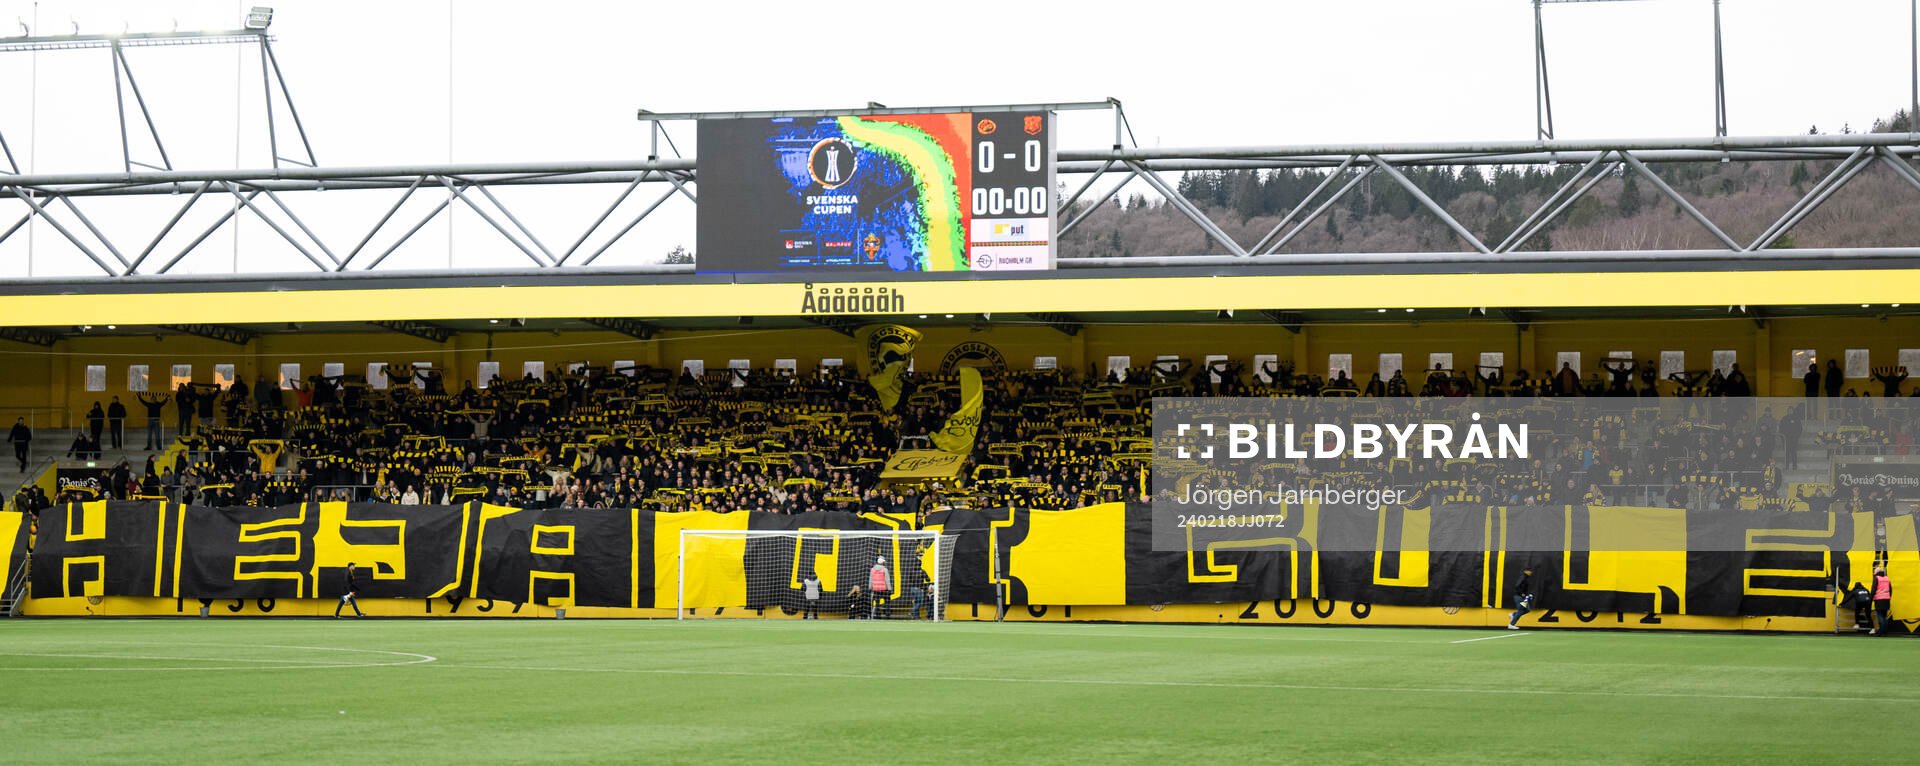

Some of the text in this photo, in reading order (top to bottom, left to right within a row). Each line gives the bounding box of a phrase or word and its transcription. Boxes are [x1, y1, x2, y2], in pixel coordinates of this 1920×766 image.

[979, 141, 995, 173] 0
[1025, 140, 1041, 172] 0
[806, 195, 858, 205] SVENSKA
[813, 205, 852, 215] CUPEN
[1010, 225, 1024, 236] put
[801, 282, 904, 313] Ååååååh
[1840, 473, 1919, 488] Borås Tidning
[30, 499, 634, 610] HEJA
[1125, 499, 1852, 618] GULE
